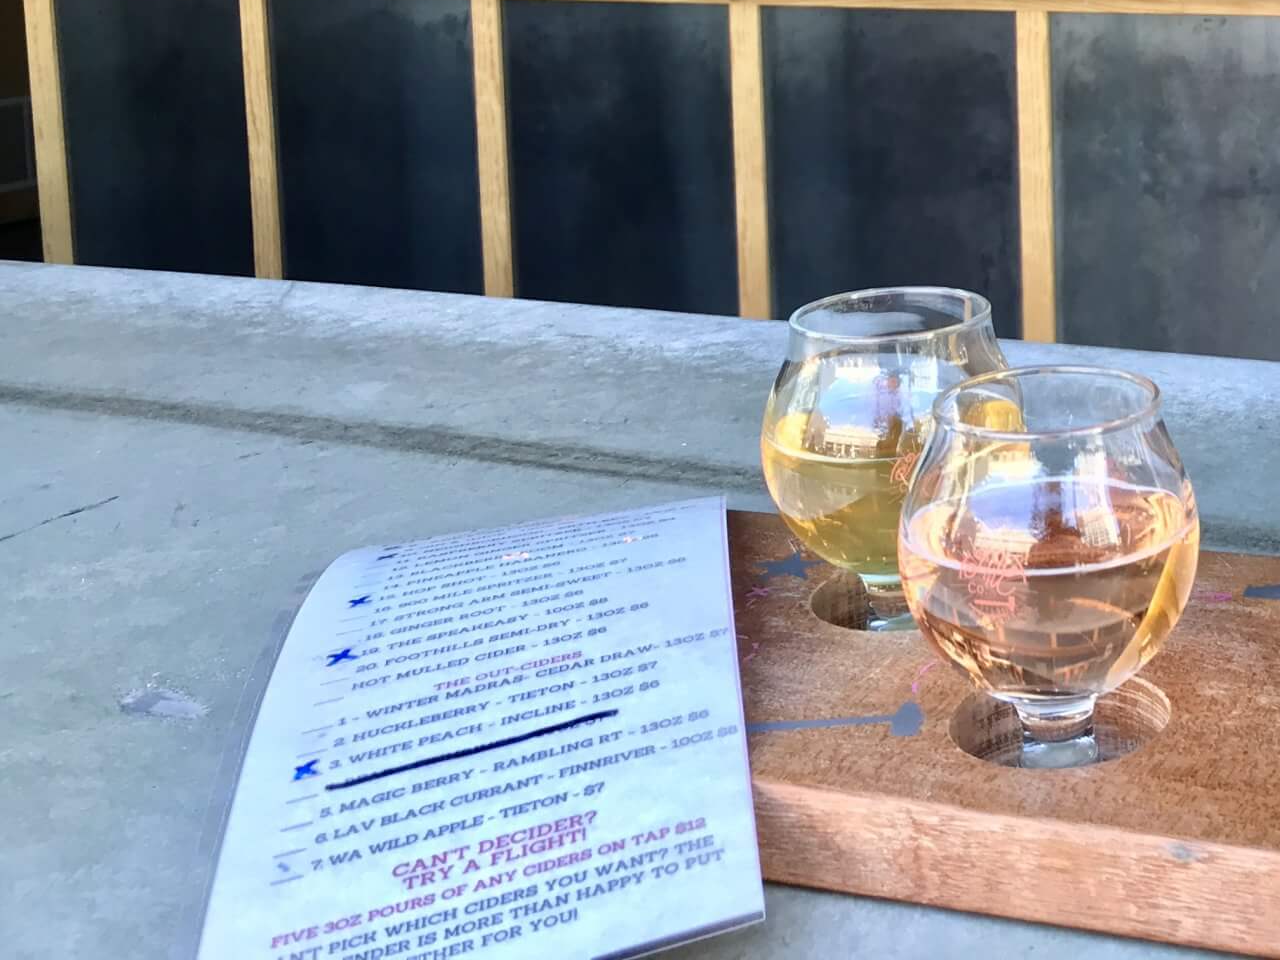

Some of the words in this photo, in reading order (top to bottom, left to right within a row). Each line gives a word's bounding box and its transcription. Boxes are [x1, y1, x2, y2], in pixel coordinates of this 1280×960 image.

[390, 617, 454, 635] GINGER
[459, 605, 506, 620] ROOT
[469, 593, 505, 605] ARM
[385, 638, 484, 666] FOOTHILLS
[489, 619, 570, 643] SEMI-DRY
[387, 637, 422, 650] THE
[426, 614, 528, 641] SPEAKEASY
[352, 675, 391, 691] HOT
[396, 658, 469, 680] MULLED
[475, 645, 525, 661] CIDER
[366, 695, 439, 718] WINTER
[536, 659, 594, 677] CEDAR
[434, 677, 470, 691] THE
[475, 651, 582, 681] OUT-CIDERS
[349, 740, 413, 763] WHITE
[418, 723, 482, 747] PEACH
[501, 700, 575, 726] INCLINE
[352, 701, 490, 742] HUCKLEBERRY
[508, 681, 574, 703] TIETON
[333, 819, 375, 840] LAV
[380, 800, 445, 827] BLACK
[450, 774, 543, 807] CURRANT
[559, 745, 656, 778] FINNRIVER
[339, 787, 406, 813] MAGIC
[411, 769, 474, 794] BERRY
[493, 738, 593, 772] RAMBLING
[599, 730, 622, 744] RT
[328, 848, 363, 867] WA
[369, 834, 419, 854] WILD
[423, 815, 484, 840] APPLE
[499, 792, 568, 818] TIETON
[392, 845, 470, 877] CAN'T
[478, 810, 597, 855] DECIDER?
[403, 865, 454, 890] TRY
[462, 859, 481, 874] A
[490, 828, 586, 866] FLIGHT!
[270, 925, 320, 949] FIVE
[368, 893, 436, 922] POURS
[441, 884, 468, 900] OF
[473, 869, 517, 892] ANY
[523, 848, 592, 877] CIDERS
[598, 838, 626, 855] ON
[632, 827, 670, 846] TAP
[328, 931, 377, 955] PICK
[385, 908, 457, 938] WHICH
[464, 884, 538, 915] CIDERS
[545, 870, 588, 891] YOU
[594, 848, 668, 877] WANT?
[674, 835, 714, 855] THE
[418, 932, 437, 947] IS
[444, 912, 503, 940] MORE
[510, 892, 570, 919] THAN
[576, 871, 645, 901] HAPPY
[651, 862, 679, 879] TO
[685, 848, 725, 870] PUT
[481, 925, 522, 947] FOR
[530, 908, 578, 932] YOU!
